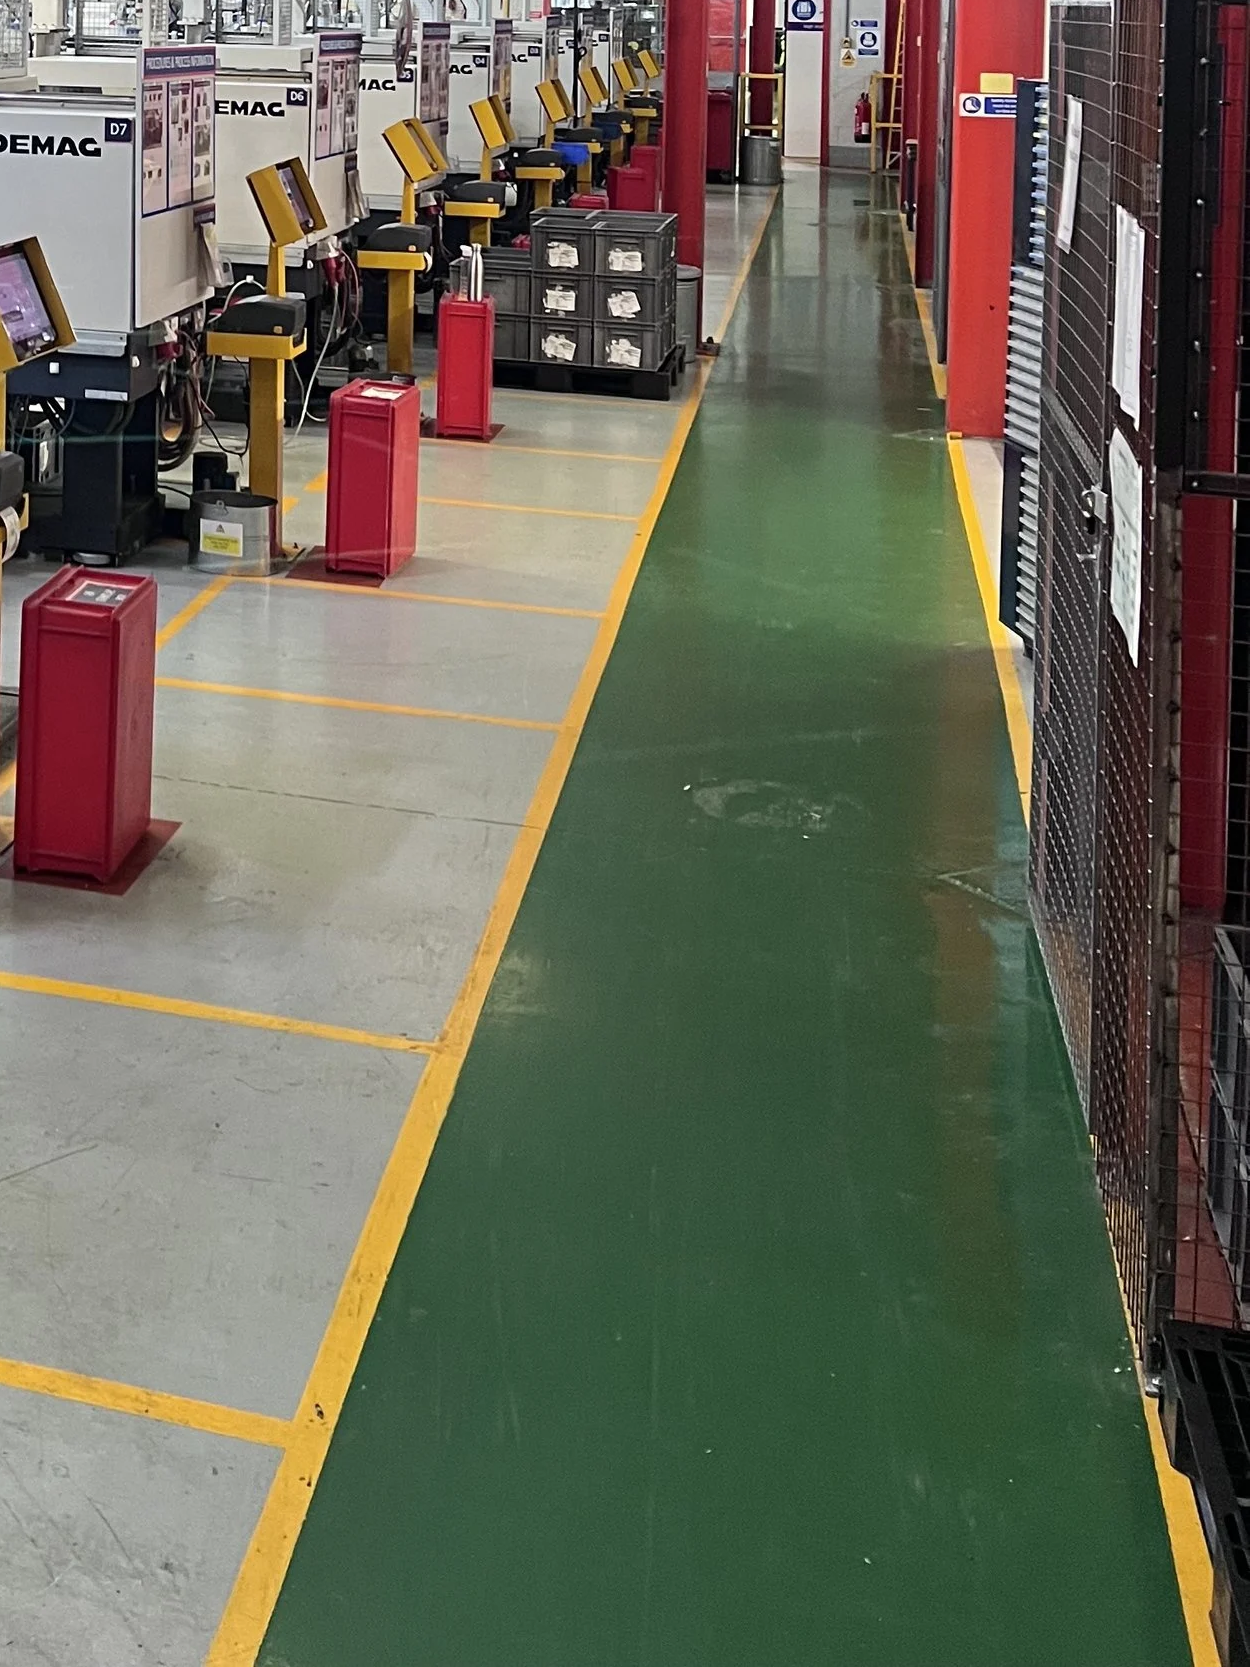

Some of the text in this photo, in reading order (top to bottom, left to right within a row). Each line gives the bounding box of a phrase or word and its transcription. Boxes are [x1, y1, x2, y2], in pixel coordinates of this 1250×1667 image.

[290, 91, 304, 102] D6
[215, 100, 285, 117] EMAG
[110, 122, 128, 136] D7
